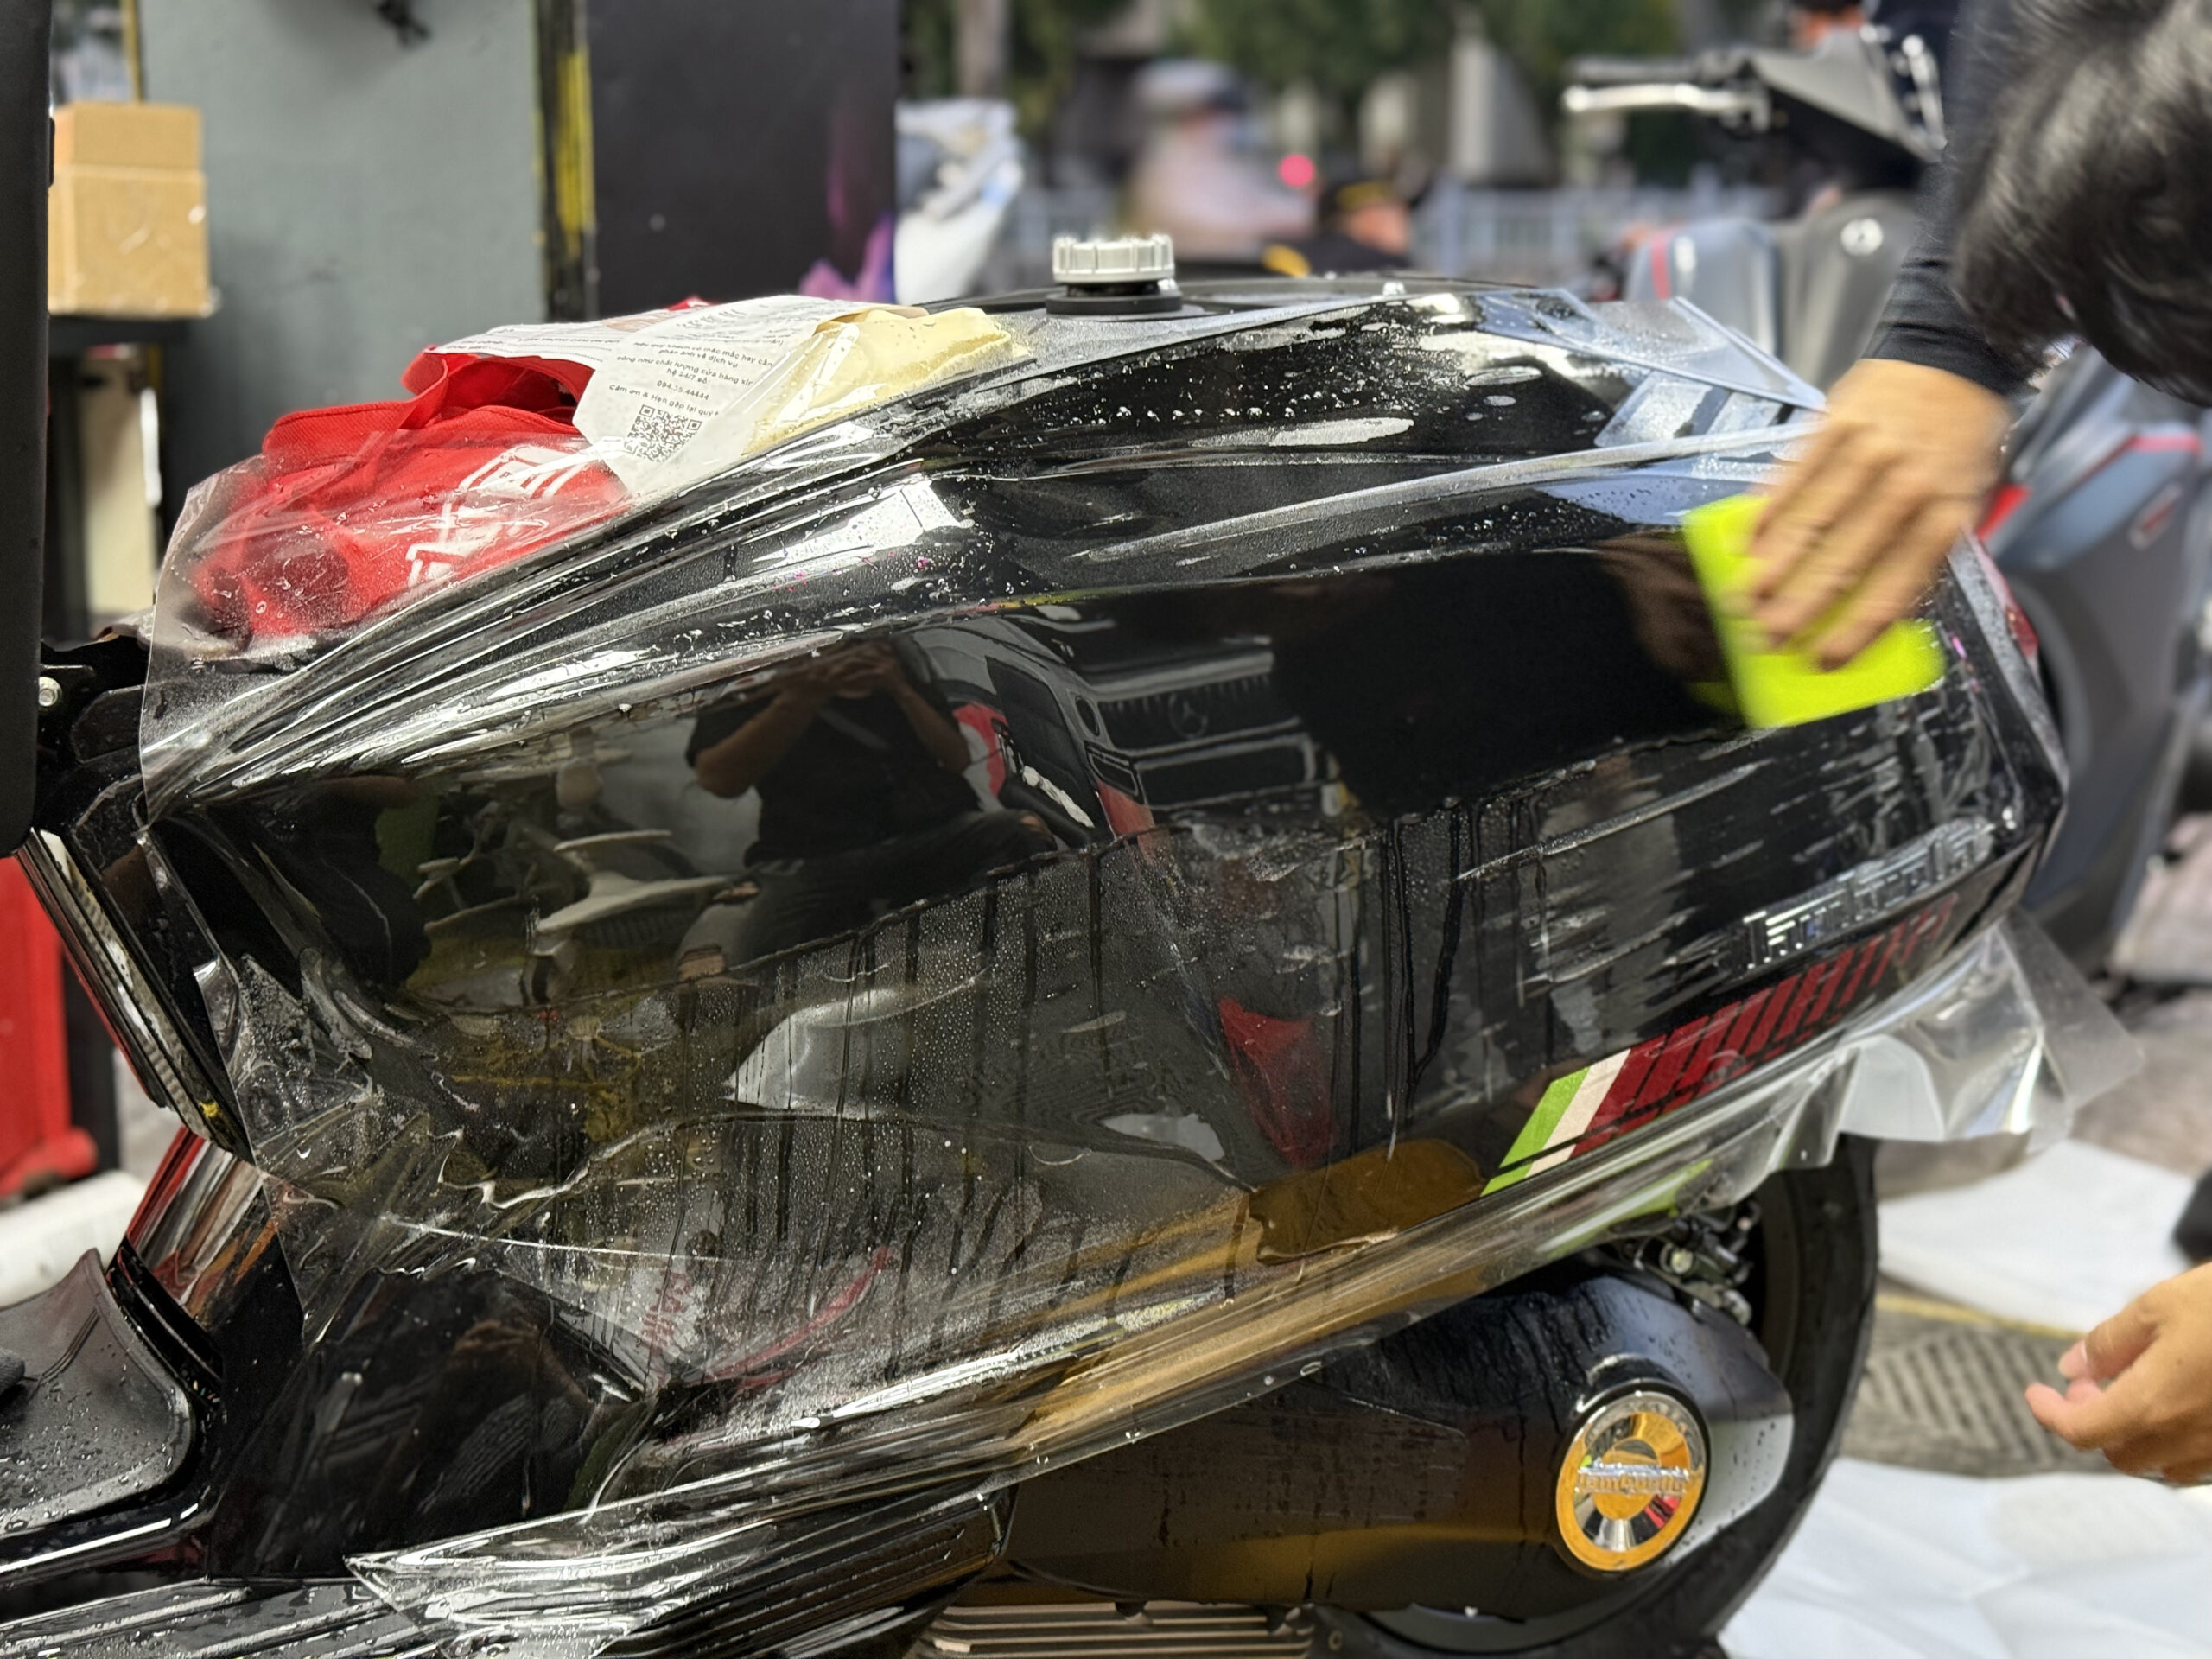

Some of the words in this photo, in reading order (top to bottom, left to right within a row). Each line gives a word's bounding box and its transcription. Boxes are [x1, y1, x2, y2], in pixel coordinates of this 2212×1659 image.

[708, 353, 727, 365] dịch
[728, 360, 739, 369] vụ
[722, 349, 740, 359] mắc
[741, 353, 756, 364] hay
[666, 366, 677, 376] hệ
[678, 371, 696, 380] 24/7
[701, 365, 717, 377] cửa
[719, 372, 739, 385] hàng
[651, 393, 668, 404] Hẹn
